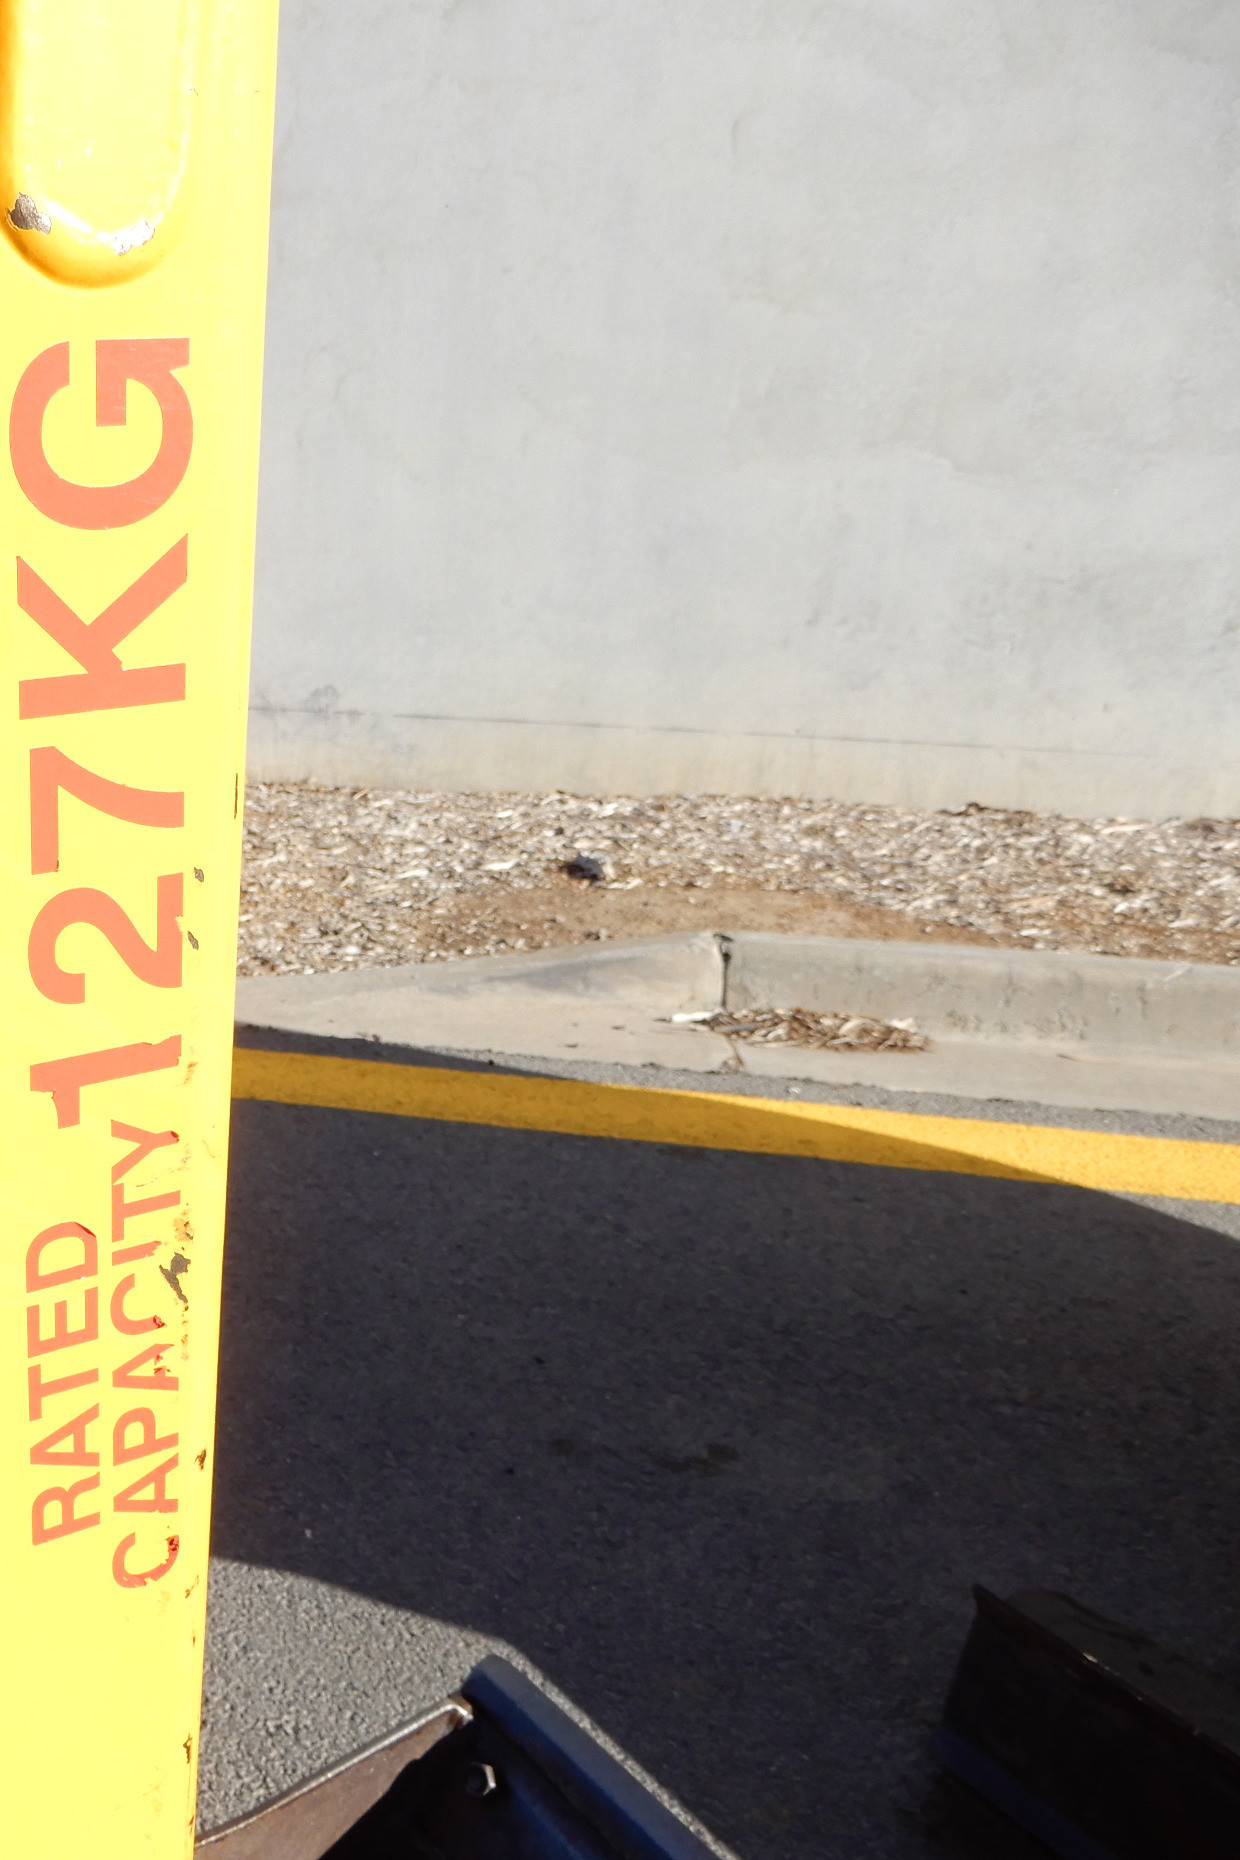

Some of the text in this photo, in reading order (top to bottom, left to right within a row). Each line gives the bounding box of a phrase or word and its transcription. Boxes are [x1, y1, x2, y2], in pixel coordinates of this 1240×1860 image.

[9, 337, 194, 1129] 127KG
[26, 1221, 101, 1546] RATED
[110, 1119, 181, 1589] CAPACITY
